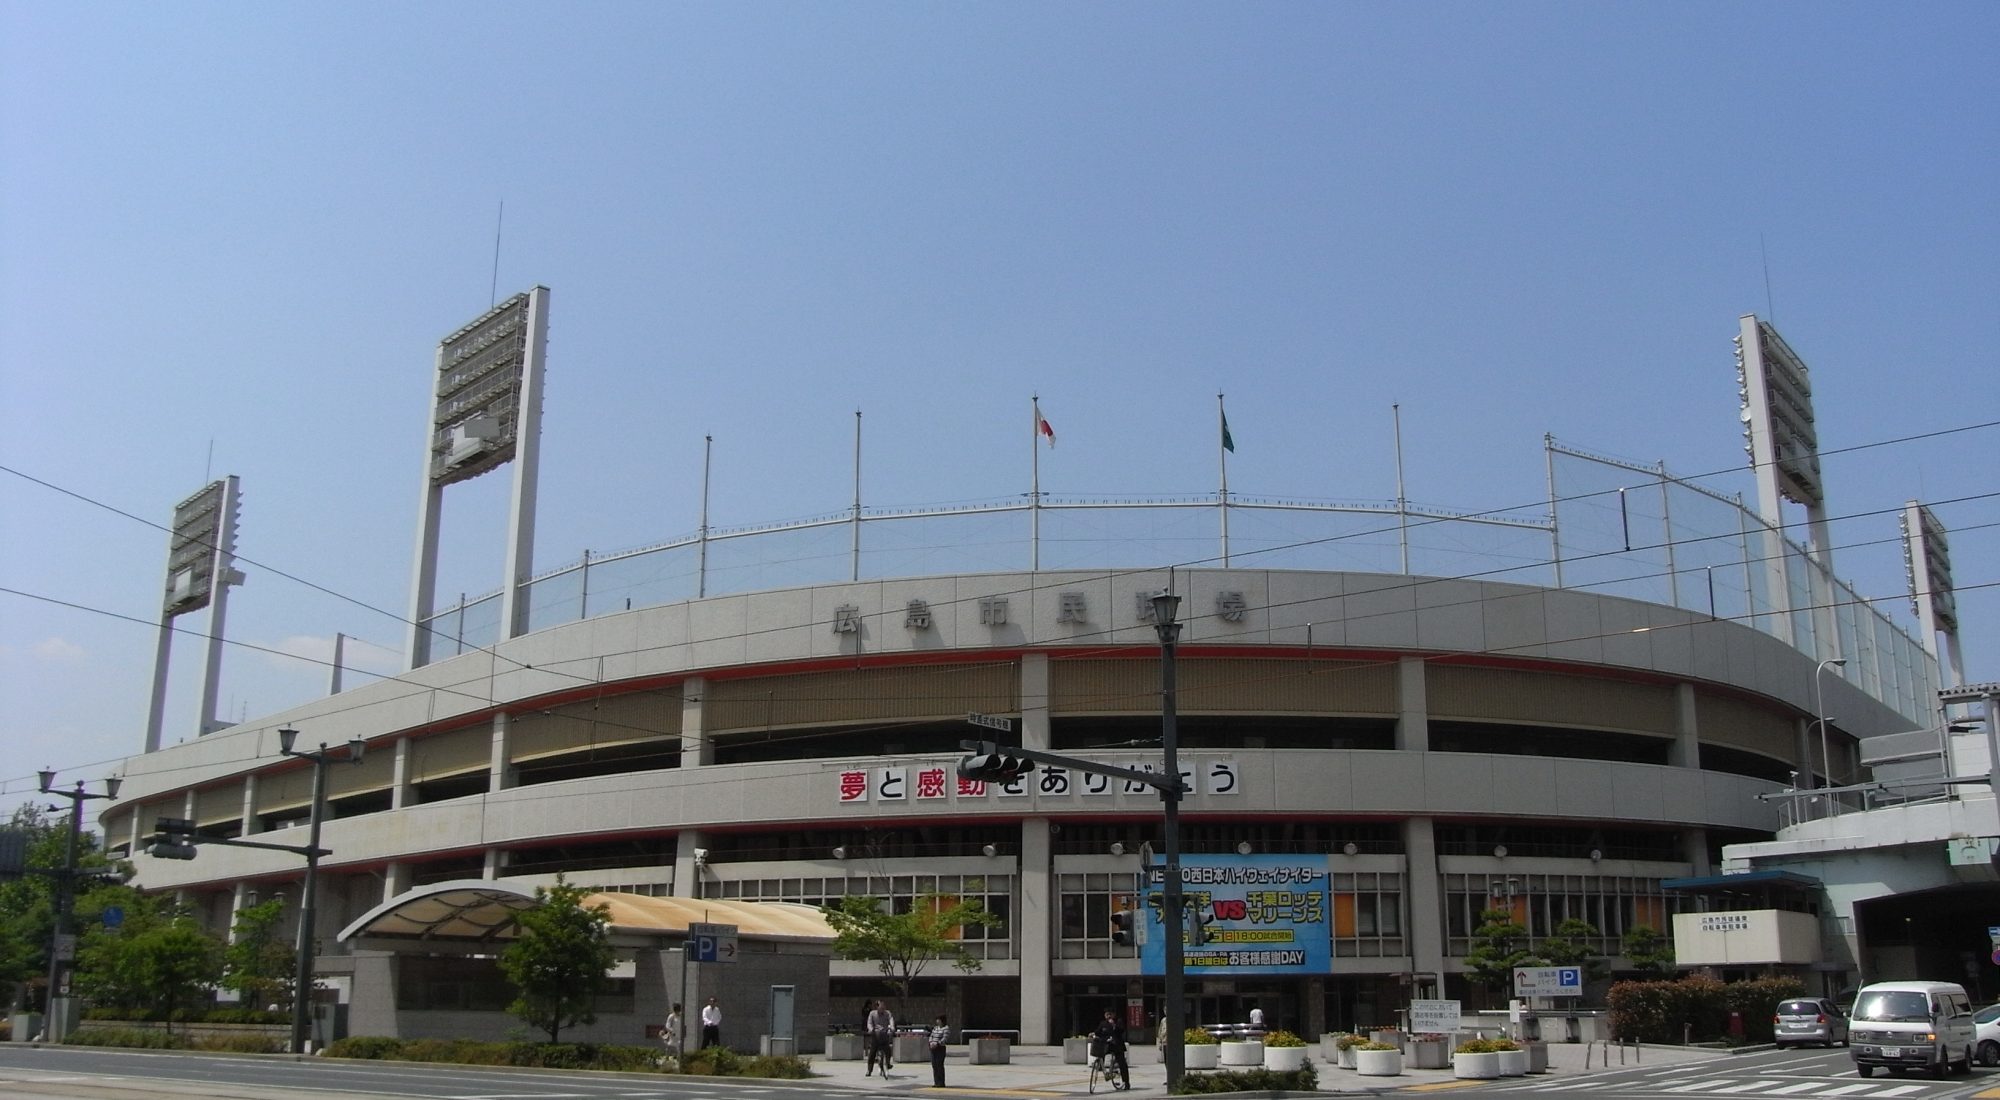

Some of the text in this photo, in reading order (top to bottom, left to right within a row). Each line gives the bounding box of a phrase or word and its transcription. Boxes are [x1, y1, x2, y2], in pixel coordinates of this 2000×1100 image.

[1150, 867, 1323, 884] NEO西日本ハイウェイナイター
[1247, 892, 1323, 907] 千葉ロッテ
[1213, 901, 1247, 921] VS
[699, 936, 713, 960] P
[1562, 971, 1574, 985] P
